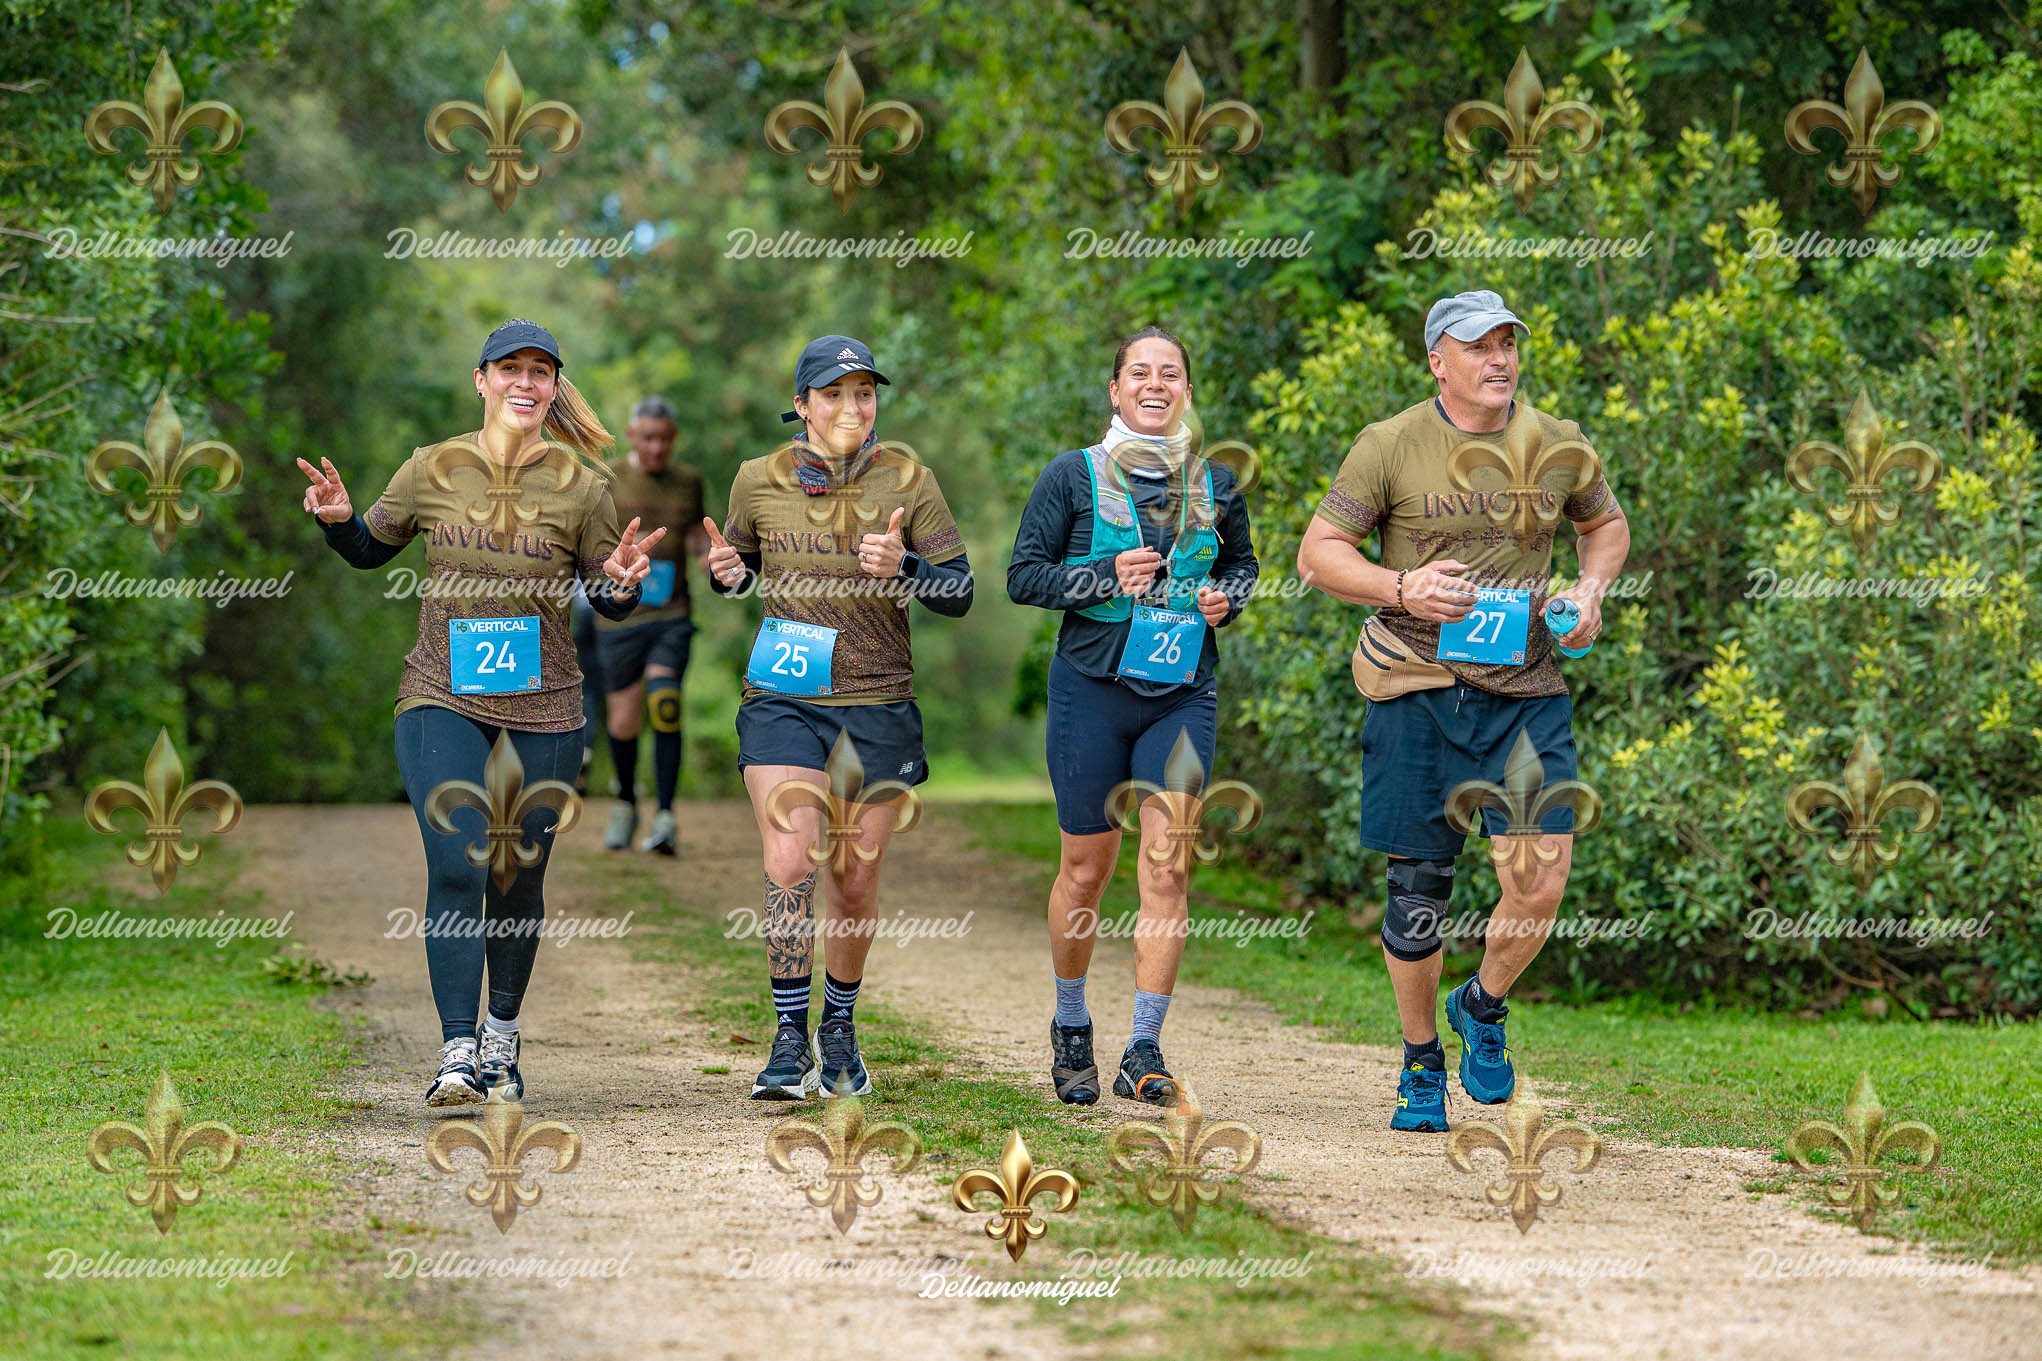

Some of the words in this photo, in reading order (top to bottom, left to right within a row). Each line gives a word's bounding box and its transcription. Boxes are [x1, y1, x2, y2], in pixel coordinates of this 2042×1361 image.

[1424, 490, 1556, 519] INVICTUS
[432, 521, 555, 560] INVICTUS
[767, 529, 864, 556] INVICTU
[468, 620, 529, 633] VERTICAL
[777, 622, 825, 640] VERTICAL
[1150, 611, 1198, 625] VERTICAL
[1466, 610, 1506, 644] 27
[475, 640, 517, 674] 24
[771, 641, 810, 678] 25
[1147, 631, 1182, 664] 26
